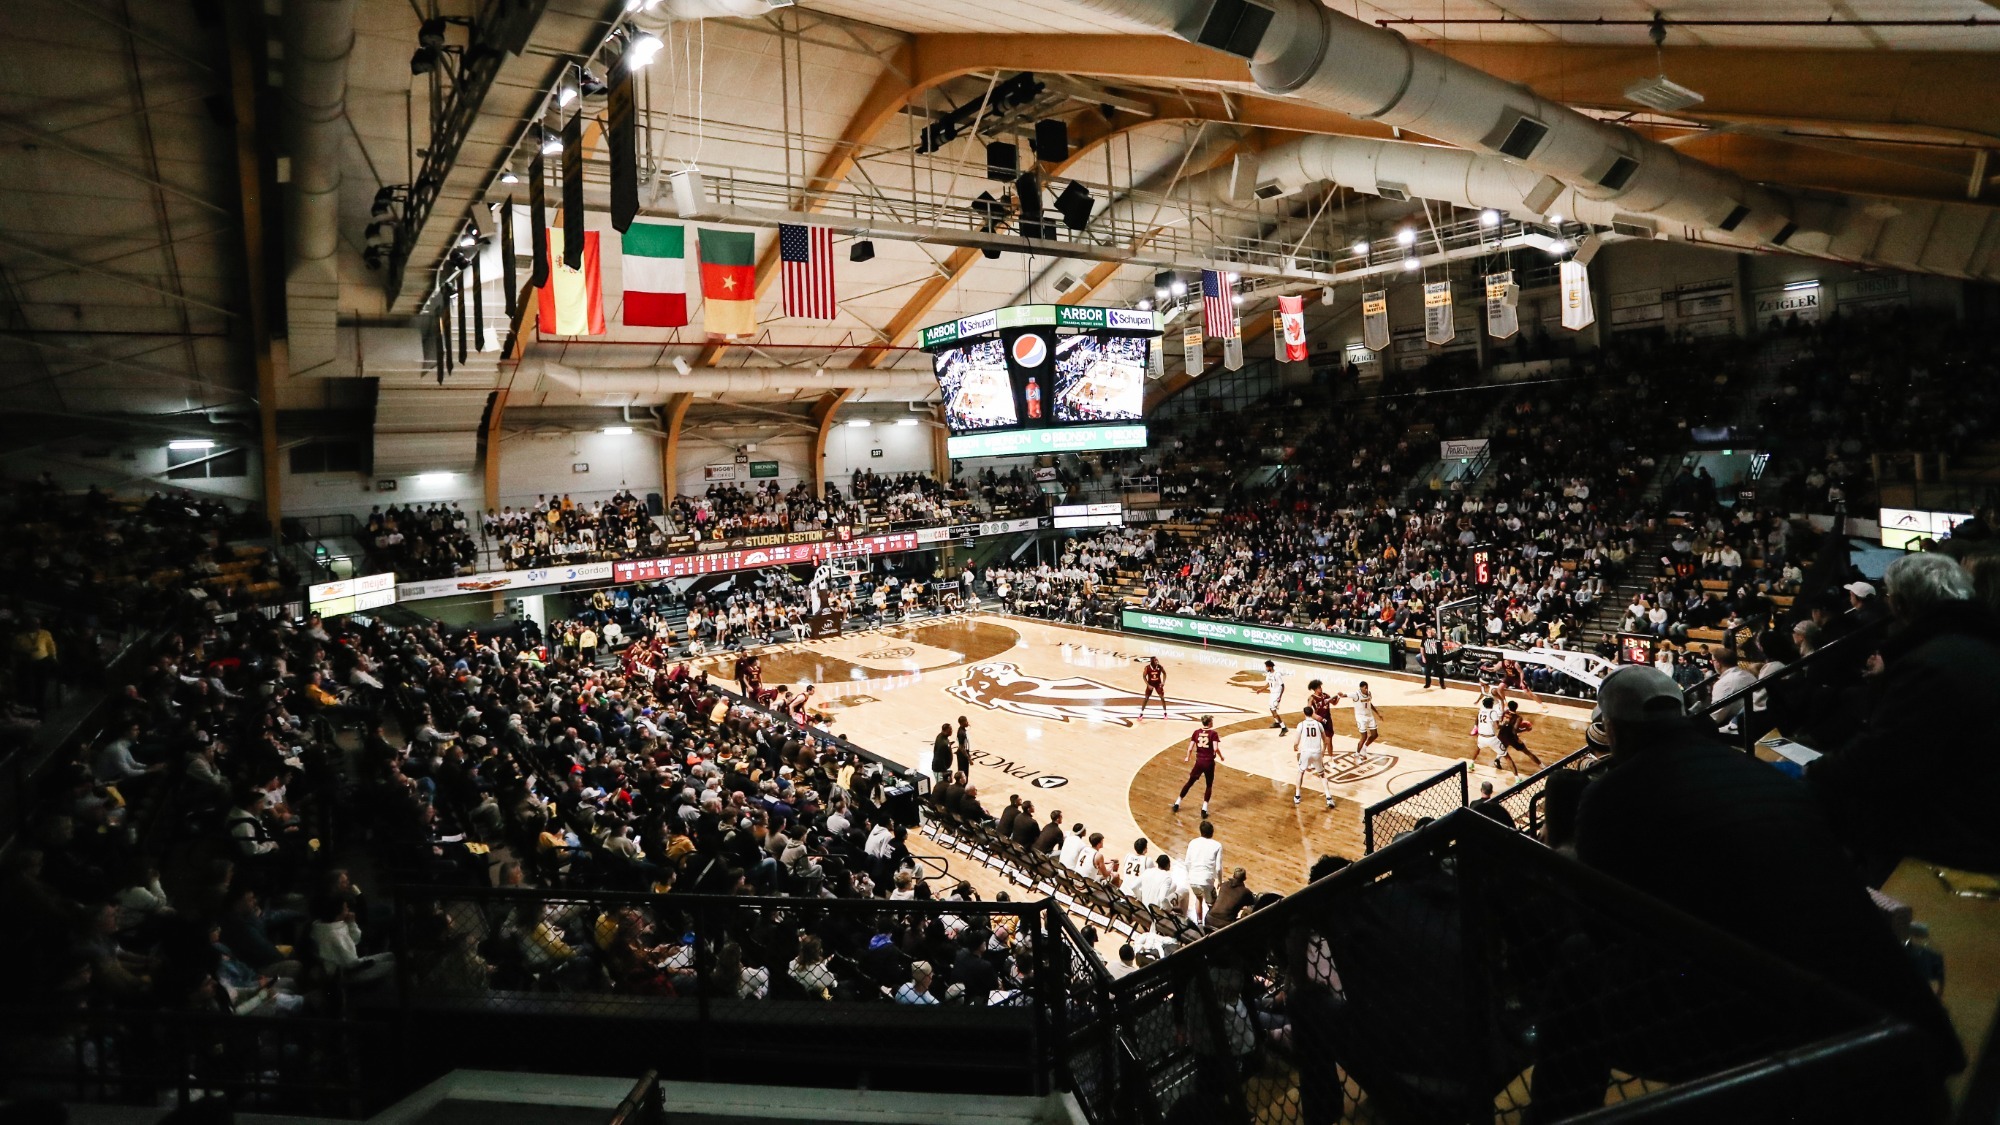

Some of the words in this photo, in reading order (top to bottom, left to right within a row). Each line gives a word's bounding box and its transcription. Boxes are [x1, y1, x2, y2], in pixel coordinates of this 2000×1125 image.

[1758, 295, 1817, 312] ZEIGLER
[1061, 307, 1103, 321] ARBOR
[1119, 313, 1151, 325] Schupan
[927, 322, 956, 340] ARBOR
[967, 317, 995, 332] Schupan
[1052, 430, 1097, 443] BRONSON
[745, 533, 785, 547] STUDENT
[787, 530, 823, 544] SECTION
[934, 529, 948, 539] CAFE
[577, 566, 609, 576] Gordon
[617, 563, 635, 571] WMU
[657, 559, 671, 567] CMU
[626, 570, 632, 579] 9
[660, 566, 669, 575] 14
[1478, 563, 1488, 582] 15
[362, 577, 387, 590] meijer
[357, 594, 393, 610] ZEIGLER
[1148, 615, 1184, 628] BRONSON
[1197, 622, 1237, 635] BRONSON
[1251, 630, 1295, 644] BRONSON
[1624, 638, 1651, 649] 13:14
[1312, 637, 1361, 653] BRONSON
[1327, 647, 1348, 656] Medicine
[1631, 649, 1645, 662] 15
[1480, 714, 1487, 723] 12
[1306, 727, 1317, 737] 10
[1197, 736, 1209, 748] 32
[1079, 855, 1087, 866] 4
[1126, 862, 1141, 877] 24
